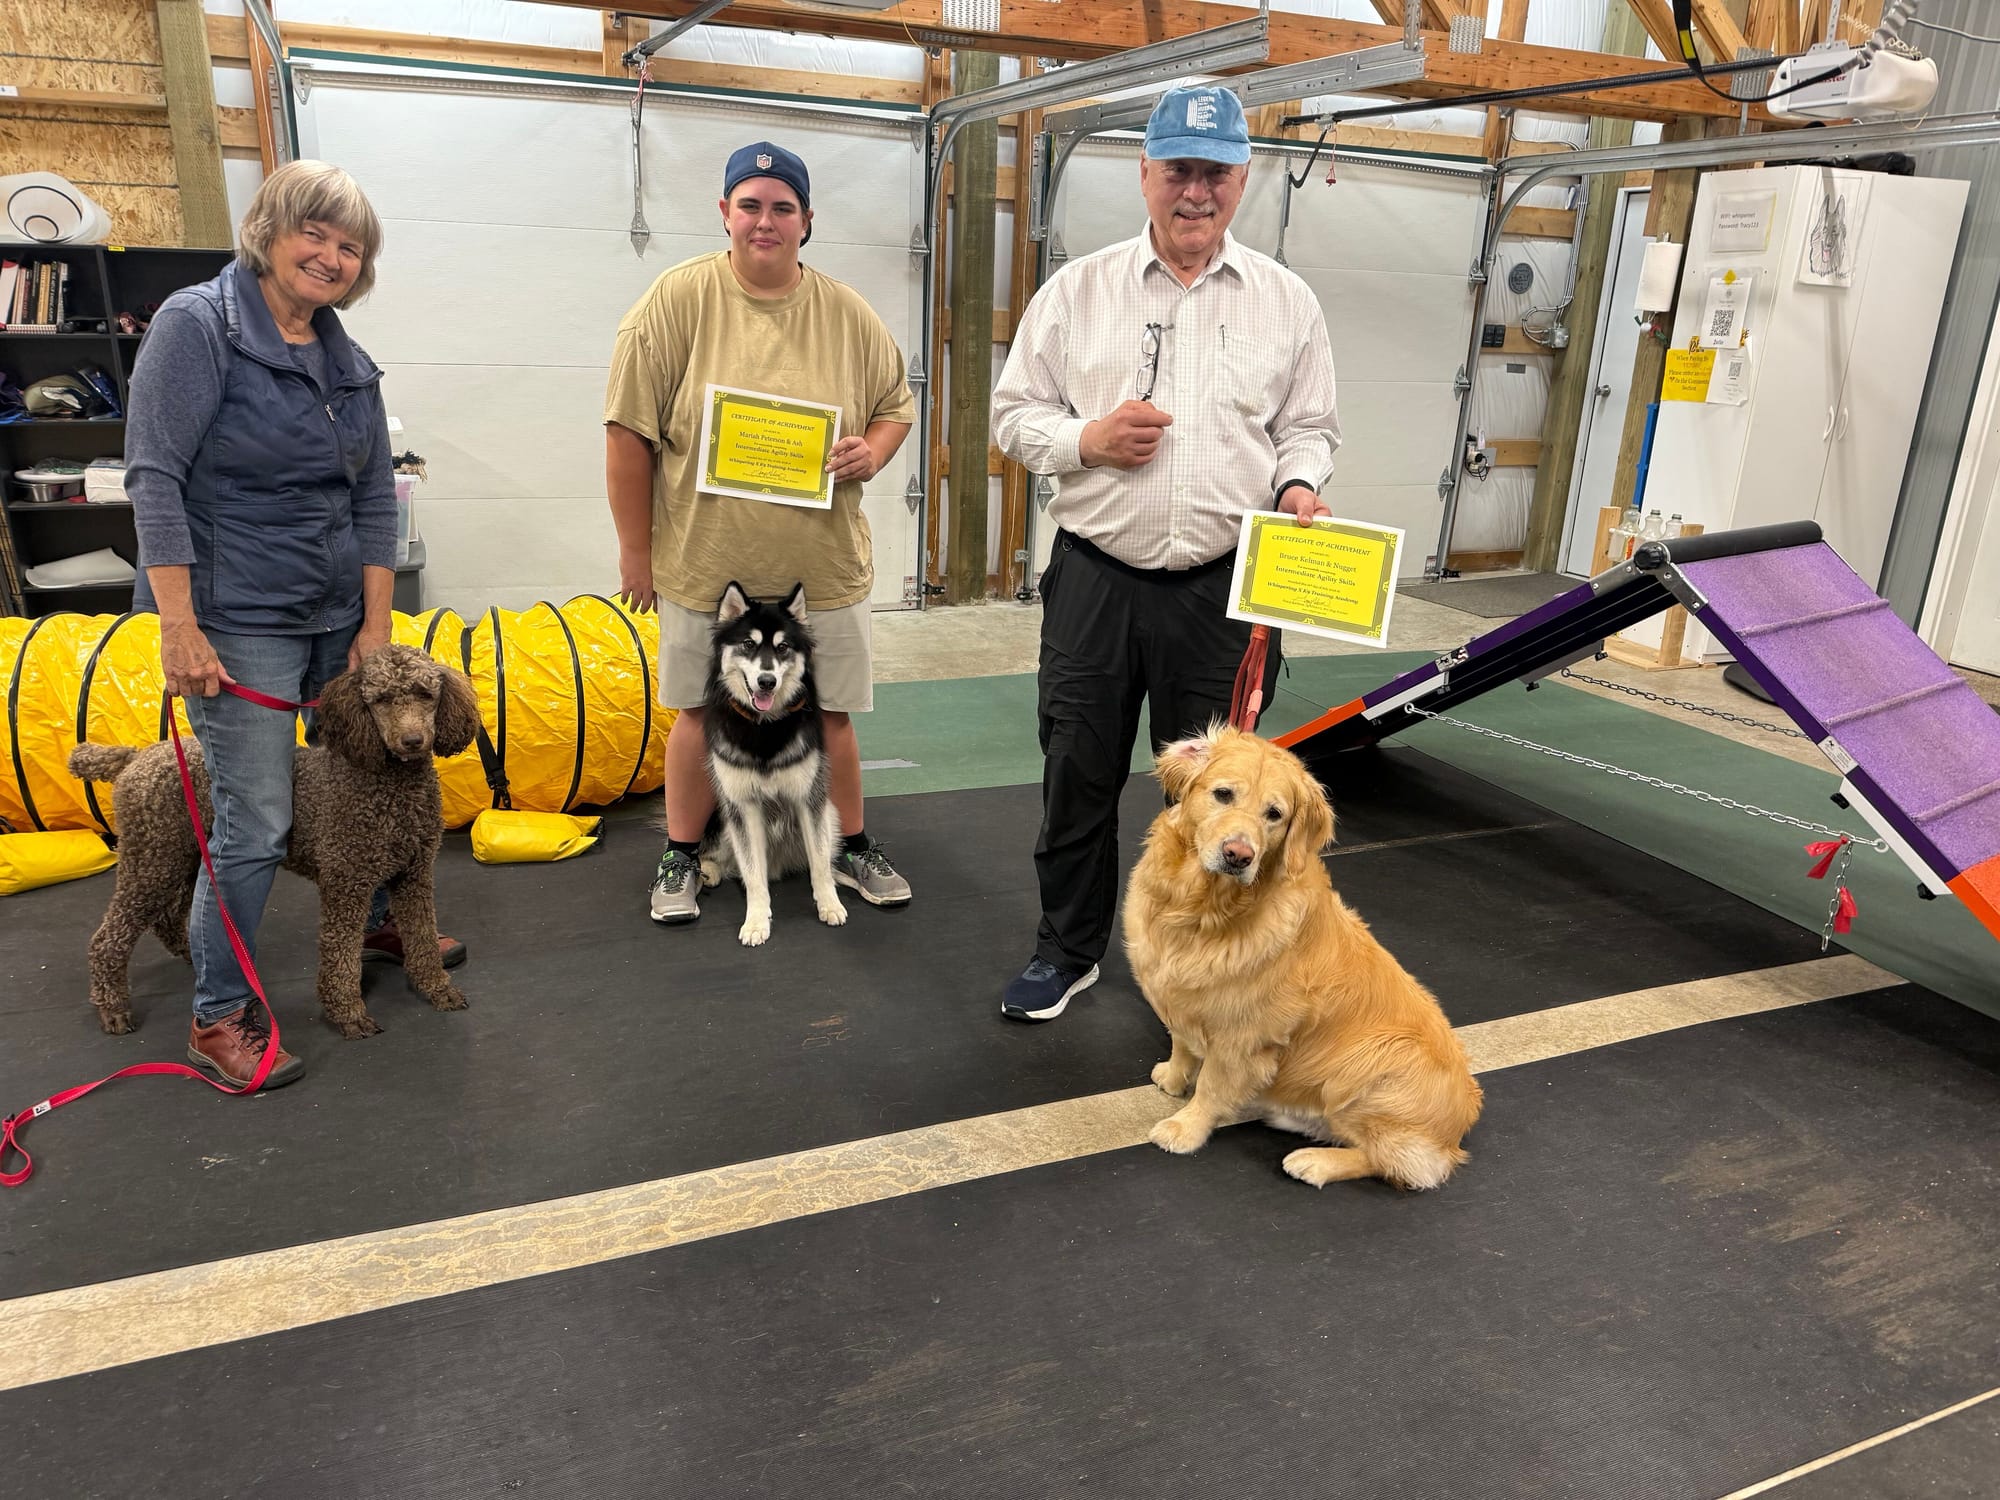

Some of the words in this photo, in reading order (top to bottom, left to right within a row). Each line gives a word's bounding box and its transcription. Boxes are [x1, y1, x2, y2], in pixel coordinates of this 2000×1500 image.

[731, 413, 767, 424] CERTIFICATE
[777, 421, 815, 431] ACHIEVEMENT
[739, 431, 760, 440] Mariah
[735, 442, 769, 453] Intermediate
[771, 449, 788, 458] Agility
[1272, 534, 1314, 546] CERTIFICATE
[1326, 543, 1371, 556] ACHIEVEMENT
[1279, 552, 1299, 561] Bruce
[1300, 555, 1325, 567] Kelman
[1326, 560, 1332, 568] &
[1333, 562, 1357, 573] Nugget
[1275, 565, 1315, 579] Intermediate
[1317, 573, 1338, 584] Agility
[1338, 578, 1356, 587] Skills
